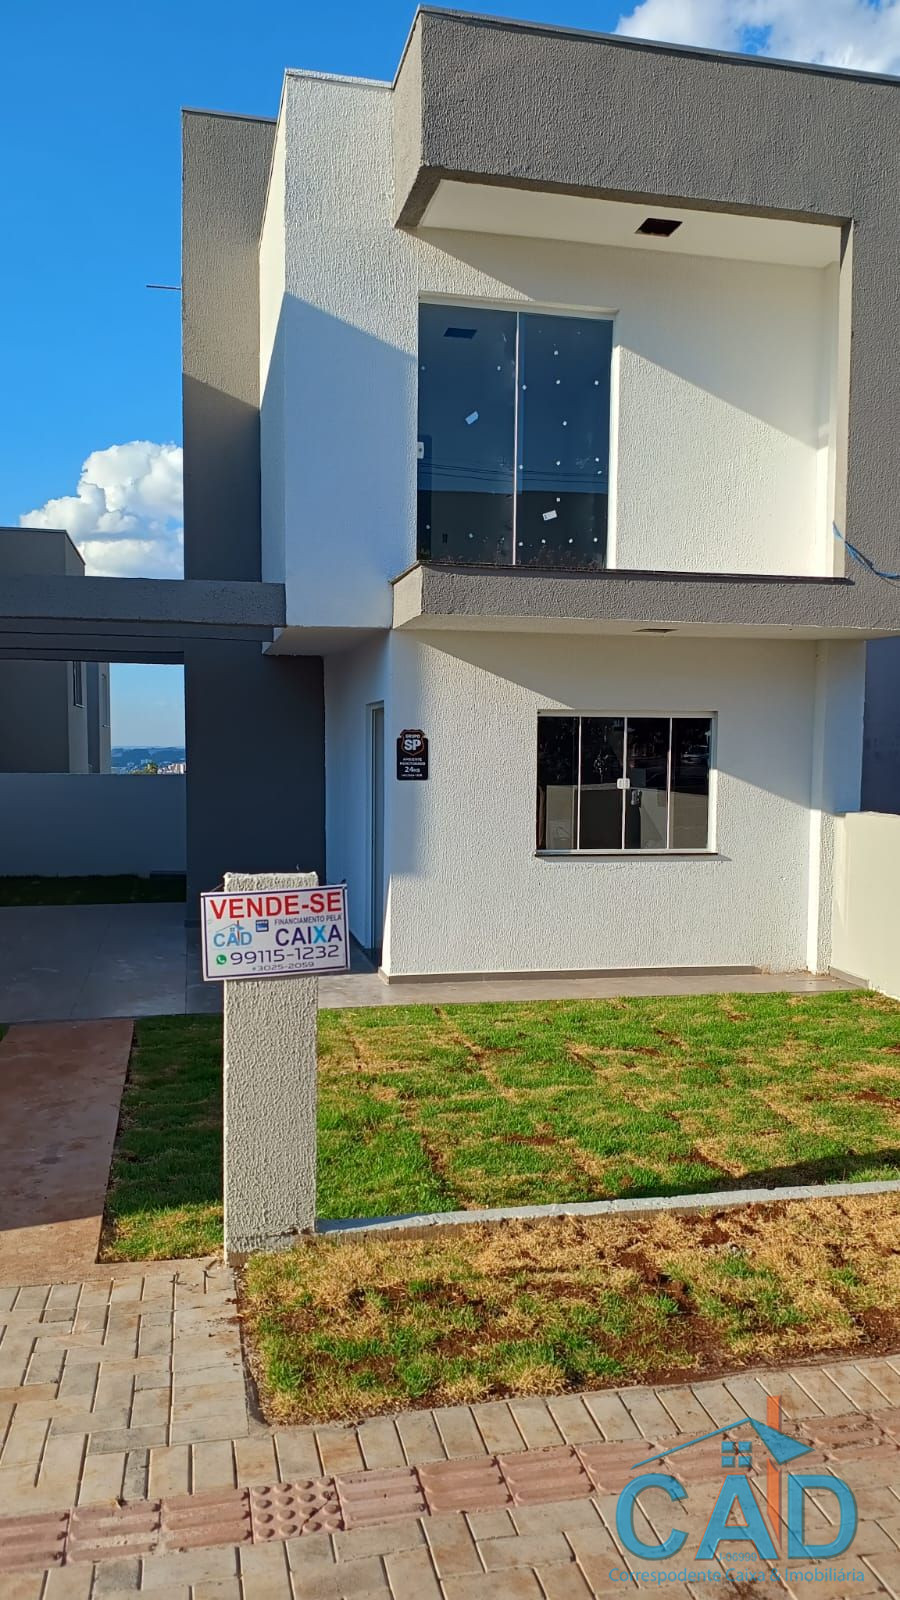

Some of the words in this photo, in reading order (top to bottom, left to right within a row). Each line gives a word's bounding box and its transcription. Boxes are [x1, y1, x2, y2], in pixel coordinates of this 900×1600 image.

[404, 739, 421, 751] SP
[209, 891, 342, 920] VENDE-SE
[274, 916, 325, 926] FINANCIAMENTO
[326, 914, 342, 922] PELA
[213, 931, 253, 948] CAD
[275, 924, 343, 947] CAIXA
[230, 944, 339, 966] 99115-1232
